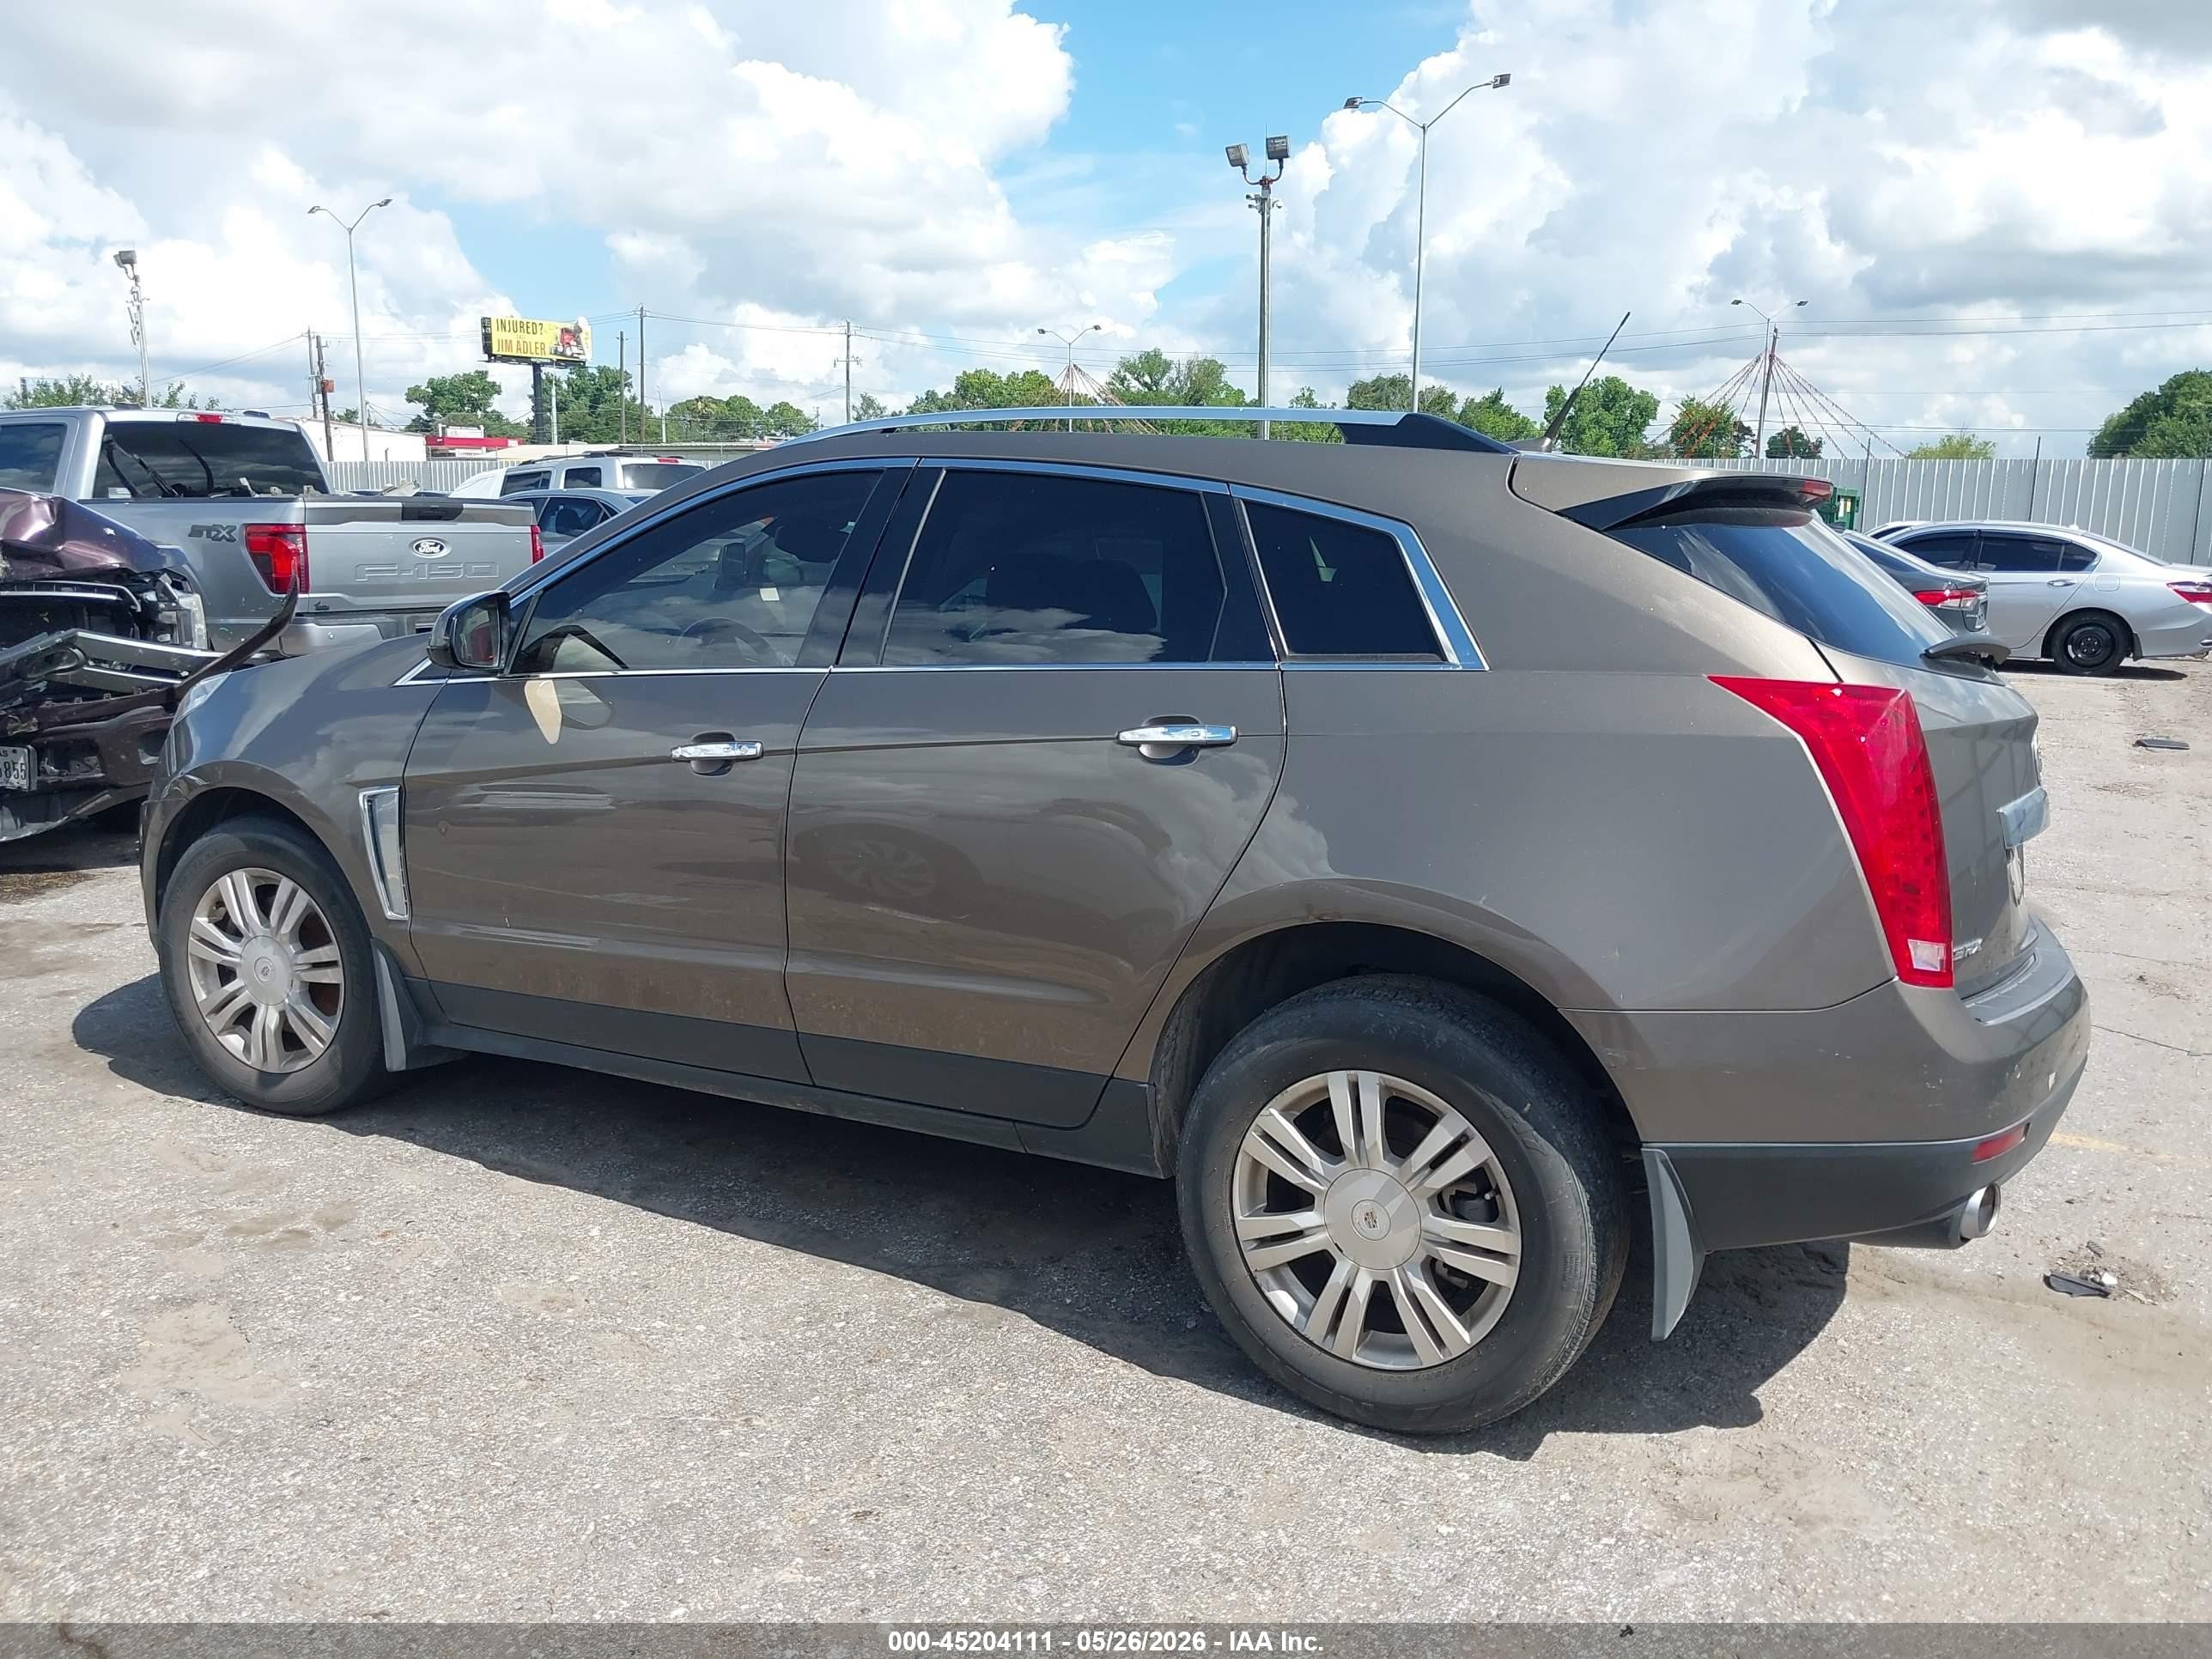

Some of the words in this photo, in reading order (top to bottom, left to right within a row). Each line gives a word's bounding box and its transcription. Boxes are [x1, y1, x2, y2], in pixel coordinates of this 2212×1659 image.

[496, 319, 544, 335] INJURED?
[496, 338, 514, 353] JIM
[515, 340, 546, 356] ADLER
[418, 540, 441, 553] Ford
[355, 562, 500, 581] F-150
[0, 761, 27, 781] 855
